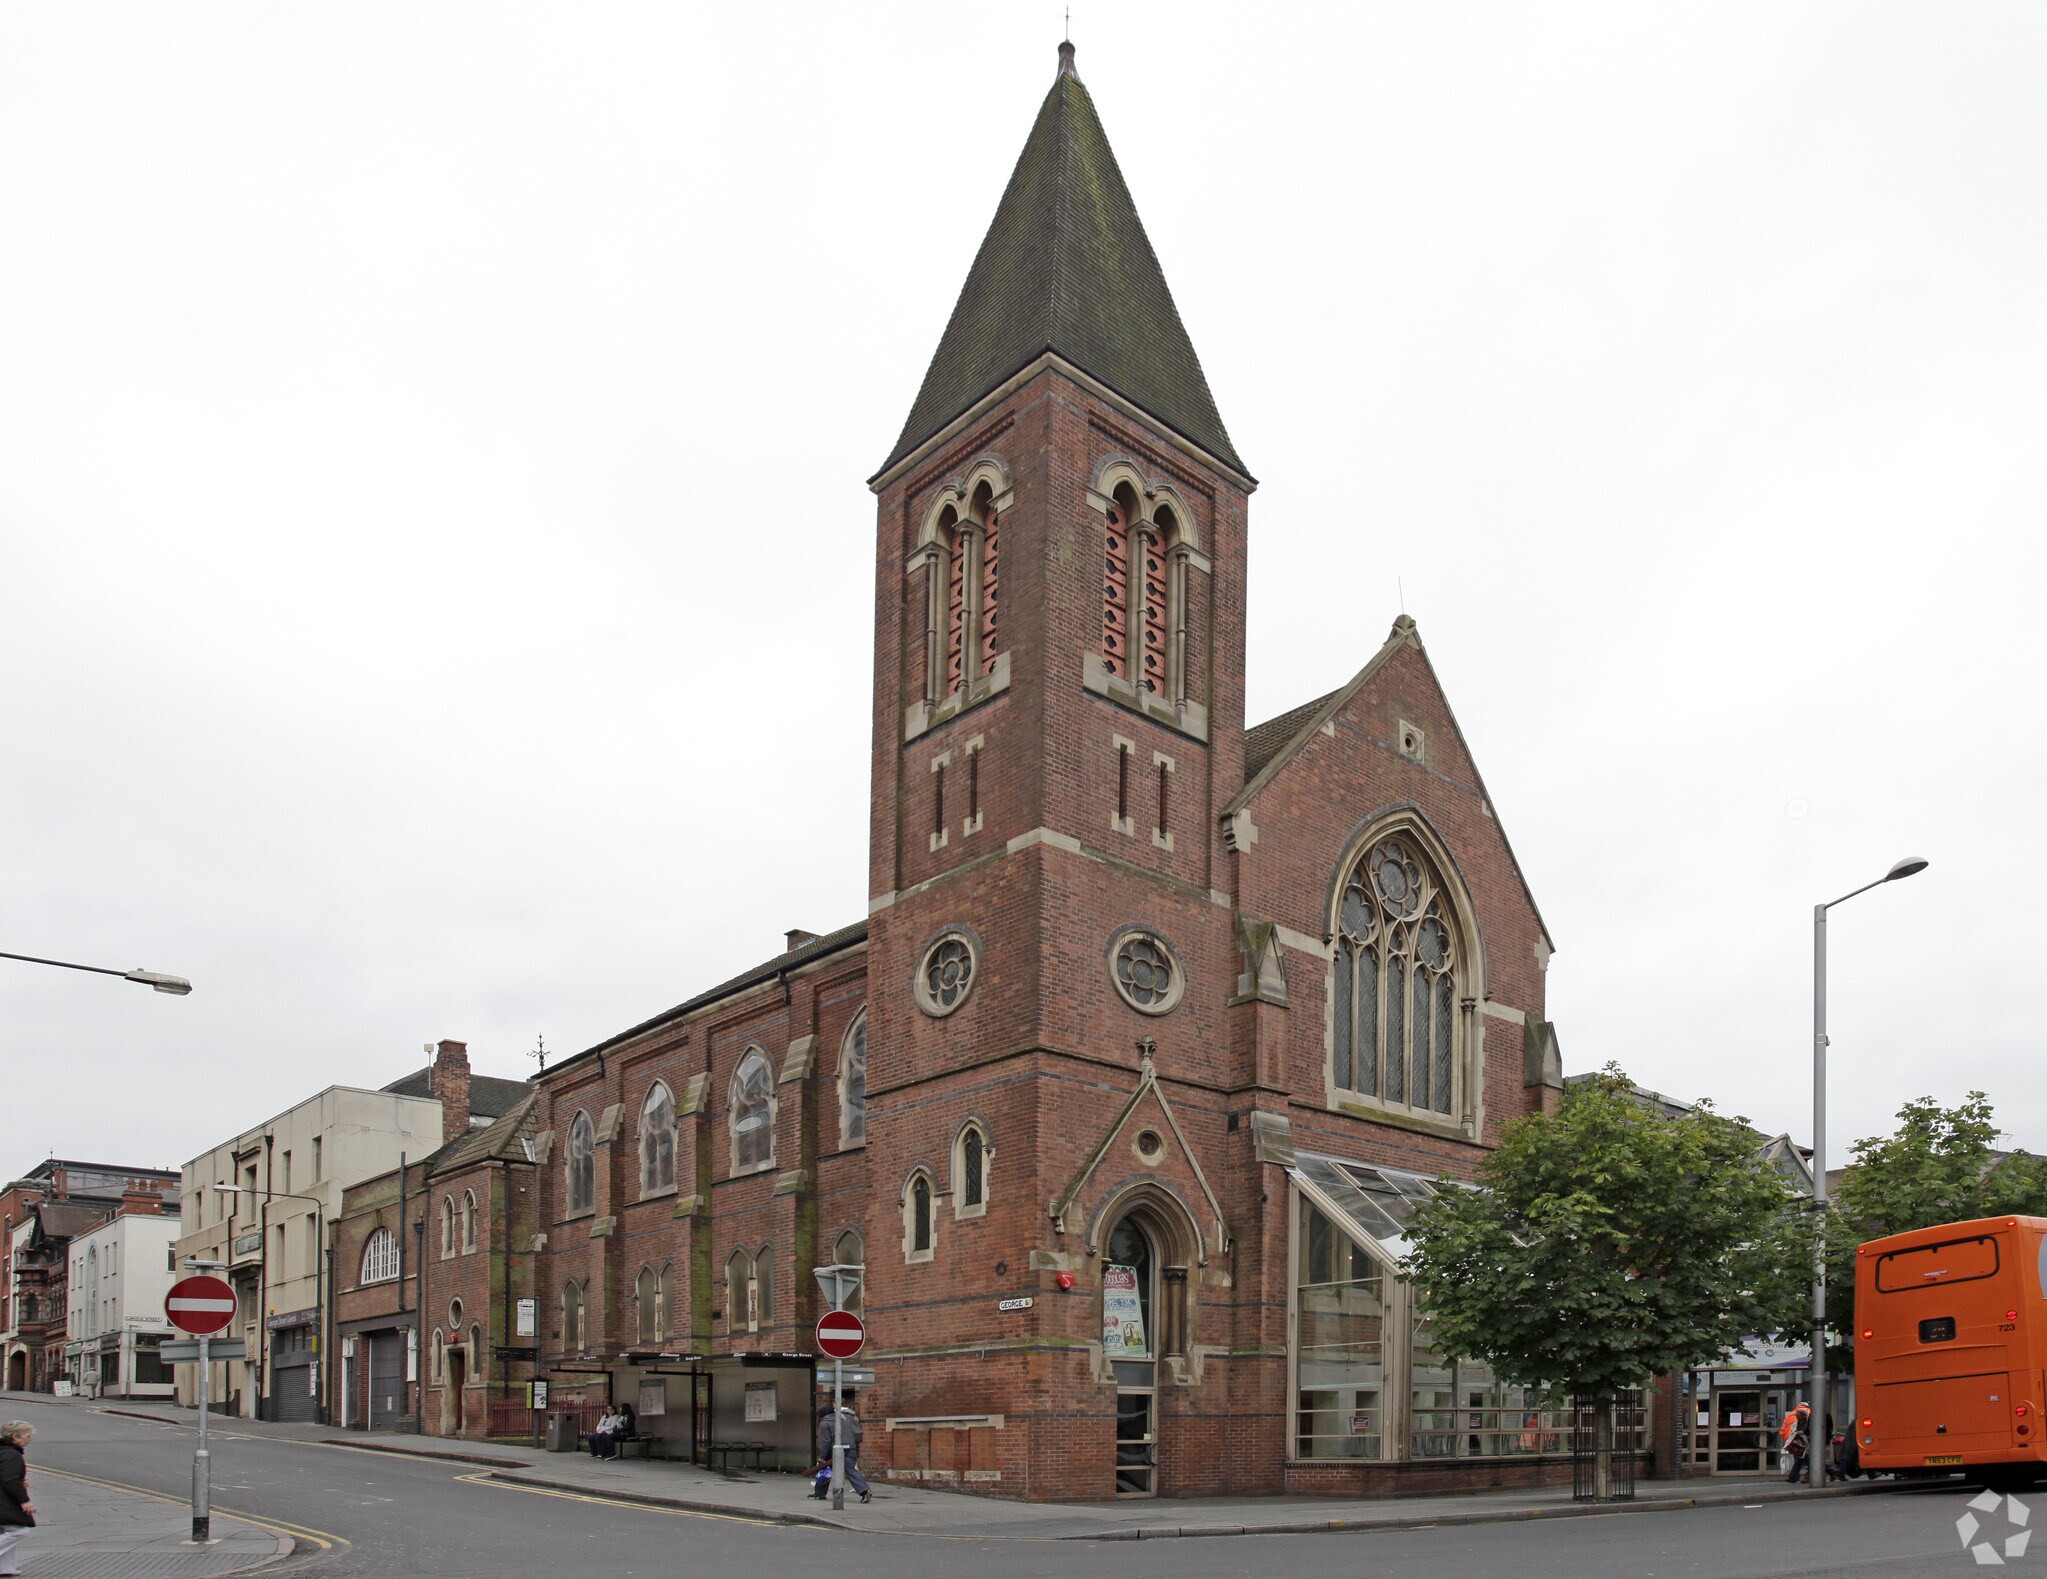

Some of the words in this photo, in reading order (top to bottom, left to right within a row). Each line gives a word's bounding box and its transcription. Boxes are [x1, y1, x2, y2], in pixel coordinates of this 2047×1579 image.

[1001, 1300, 1023, 1308] GEORGE
[268, 1318, 278, 1328] George
[279, 1316, 287, 1325] Street
[1998, 1324, 2015, 1332] 723
